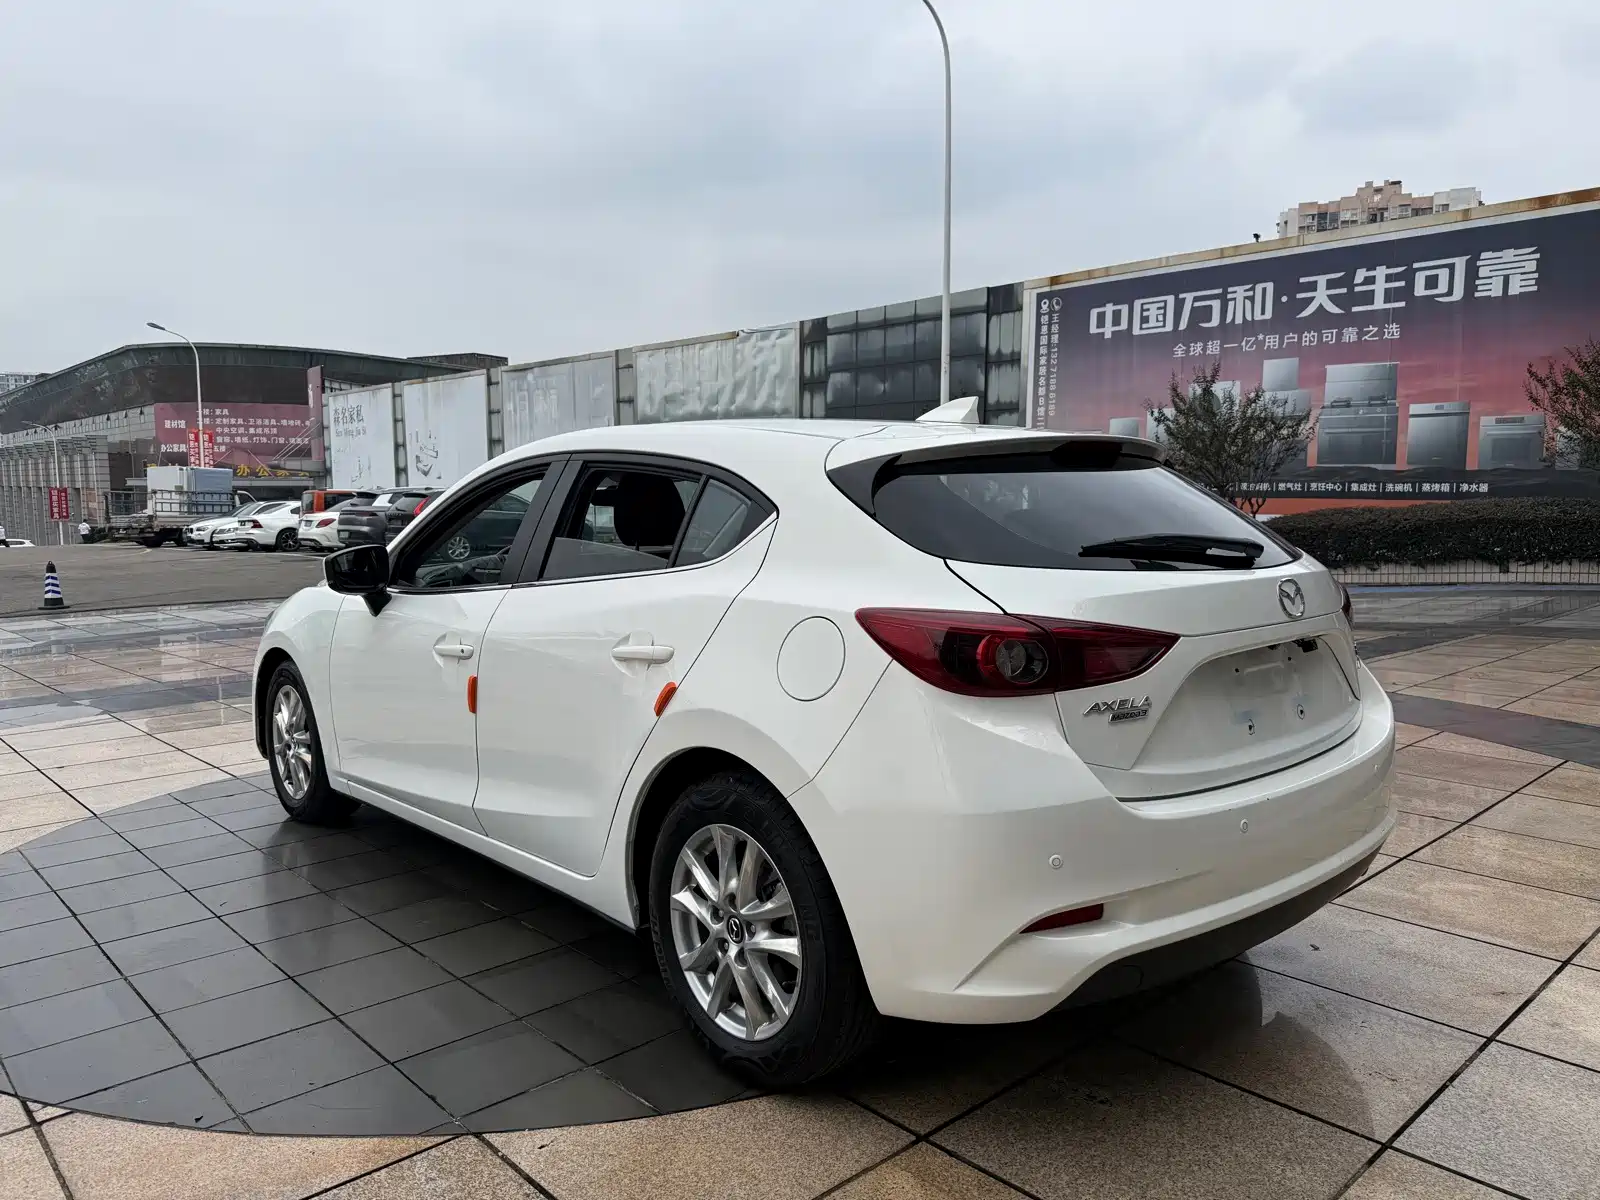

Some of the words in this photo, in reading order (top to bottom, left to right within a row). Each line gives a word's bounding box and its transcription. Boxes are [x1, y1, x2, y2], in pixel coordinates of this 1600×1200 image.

[1088, 246, 1540, 339] 中国万和·天生可靠
[164, 419, 186, 429] 建材馆
[160, 444, 189, 453] 办公家具
[1277, 482, 1302, 491] 燃气灶
[1310, 482, 1342, 492] 烹饪中心
[1350, 482, 1377, 492] 集成灶
[1385, 482, 1412, 493] 洗碗机
[1421, 482, 1450, 493] 蒸烤箱
[1459, 482, 1489, 493] 净水器
[1083, 695, 1152, 715] AXELA
